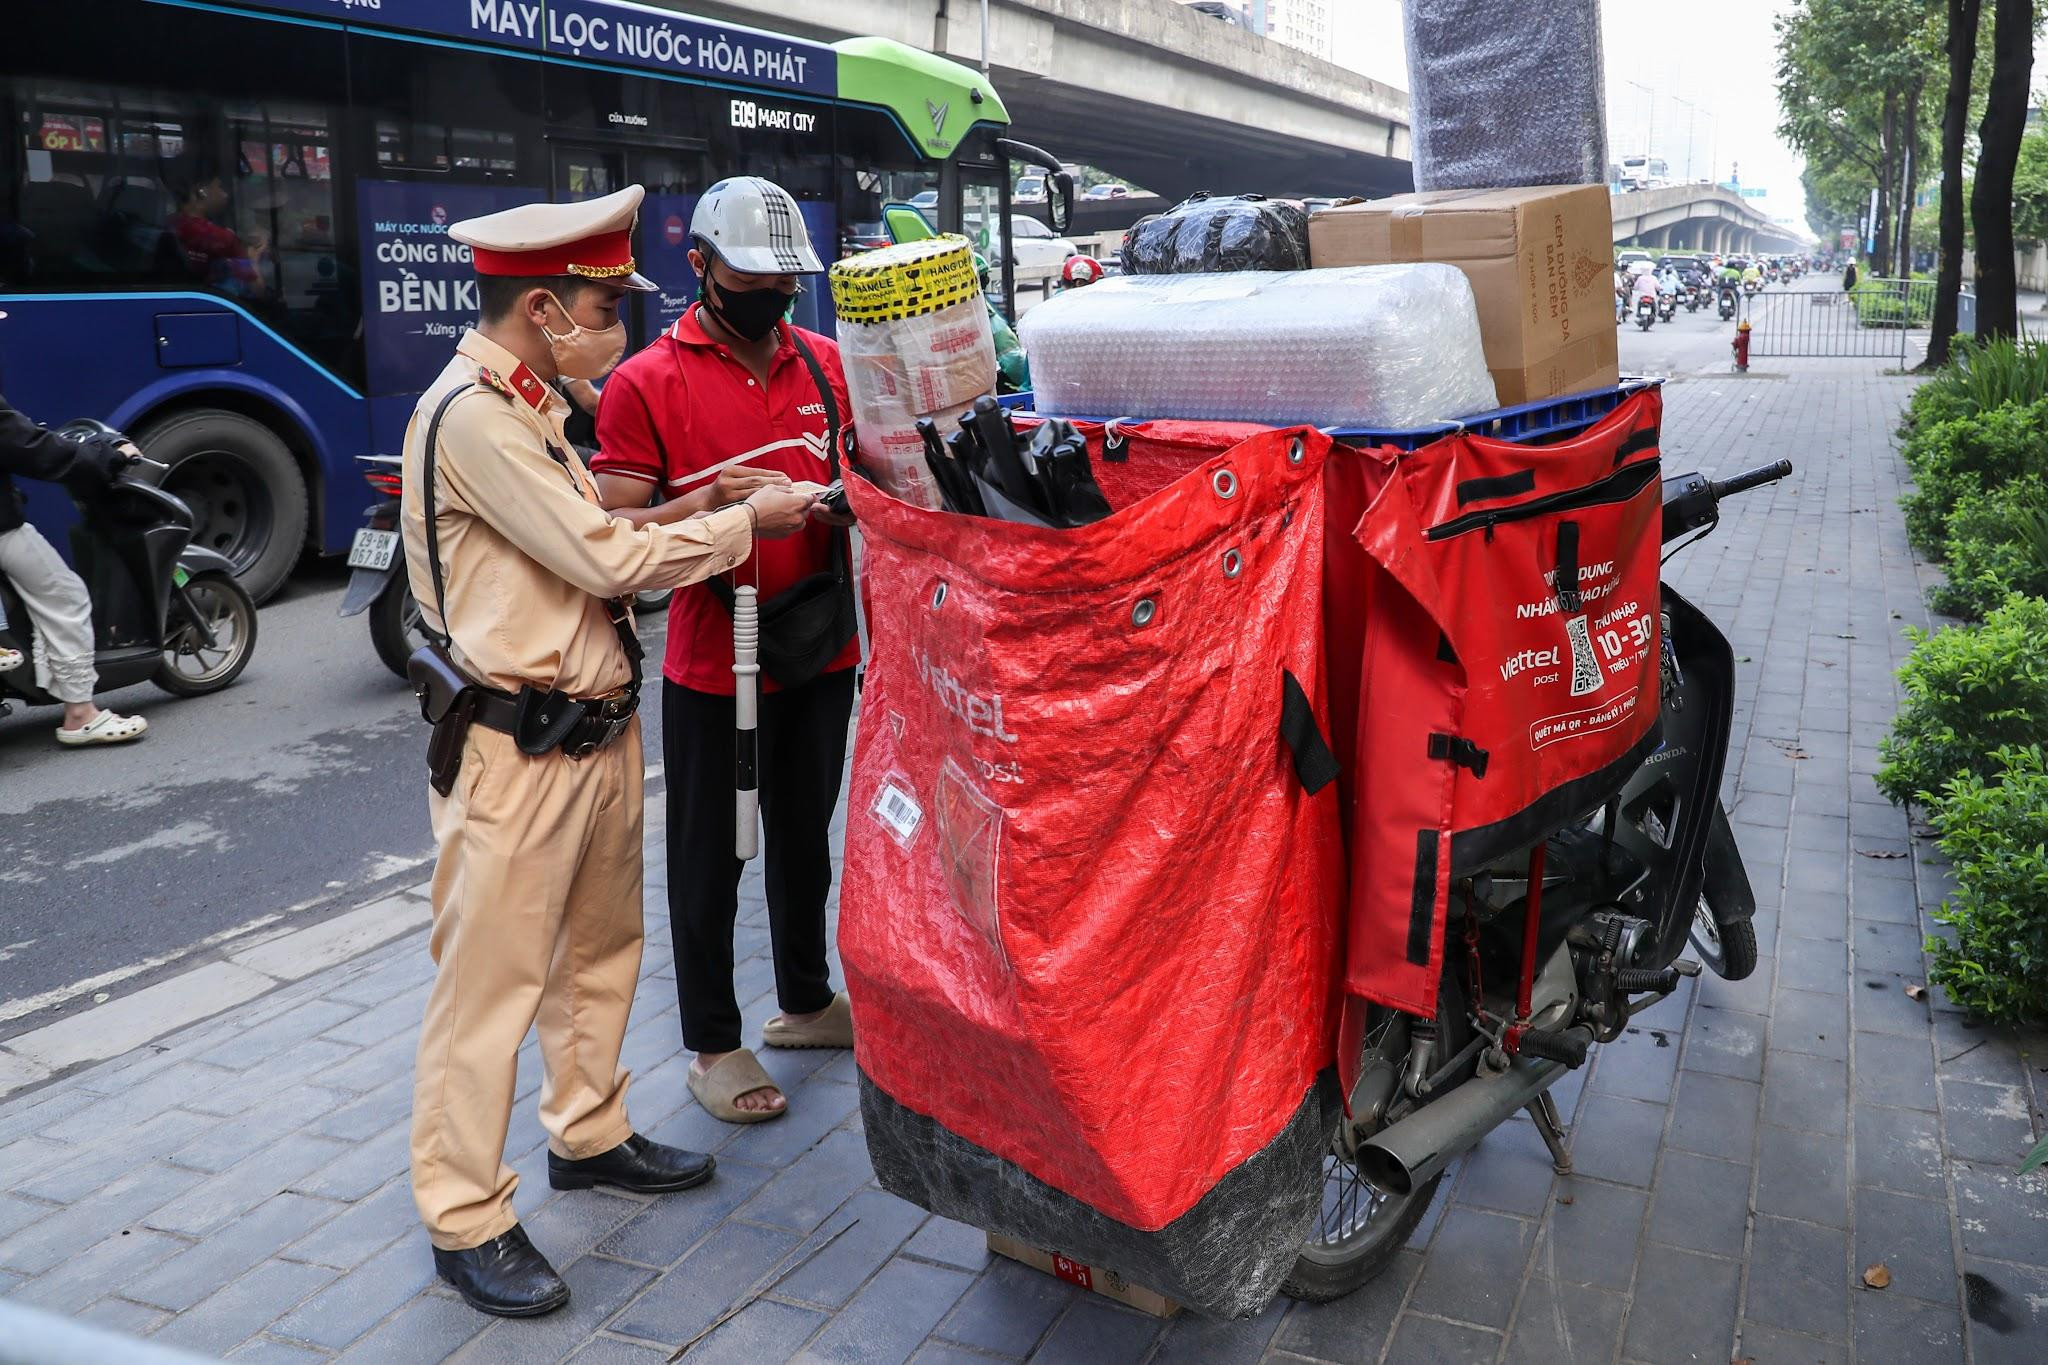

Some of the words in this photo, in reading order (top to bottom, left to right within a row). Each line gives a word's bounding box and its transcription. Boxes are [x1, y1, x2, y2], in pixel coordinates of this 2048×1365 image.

[549, 9, 609, 56] LỌC
[617, 22, 691, 65] NƯỚC
[698, 34, 749, 76] HÒA
[754, 47, 807, 83] PHÁT
[731, 99, 756, 129] E09
[758, 108, 791, 129] MART
[793, 112, 815, 132] CITY
[375, 221, 397, 233] MÁY
[400, 223, 419, 236] LỌC
[377, 238, 438, 263] CÔNG
[442, 244, 474, 263] NG
[379, 267, 448, 313] BỀN
[1554, 214, 1565, 248] KEM
[1561, 319, 1570, 342] DA
[425, 322, 456, 338] Xứng
[1577, 561, 1614, 581] DỤNG
[1578, 586, 1600, 603] IAO
[1594, 610, 1612, 631] THU
[1610, 601, 1638, 622] NHẬP
[1500, 646, 1561, 681] viettel
[1533, 673, 1559, 687] post
[1534, 725, 1551, 742] QUÉT
[1553, 721, 1567, 734] MÃ
[1568, 719, 1581, 731] QR
[1644, 746, 1687, 766] HONDA
